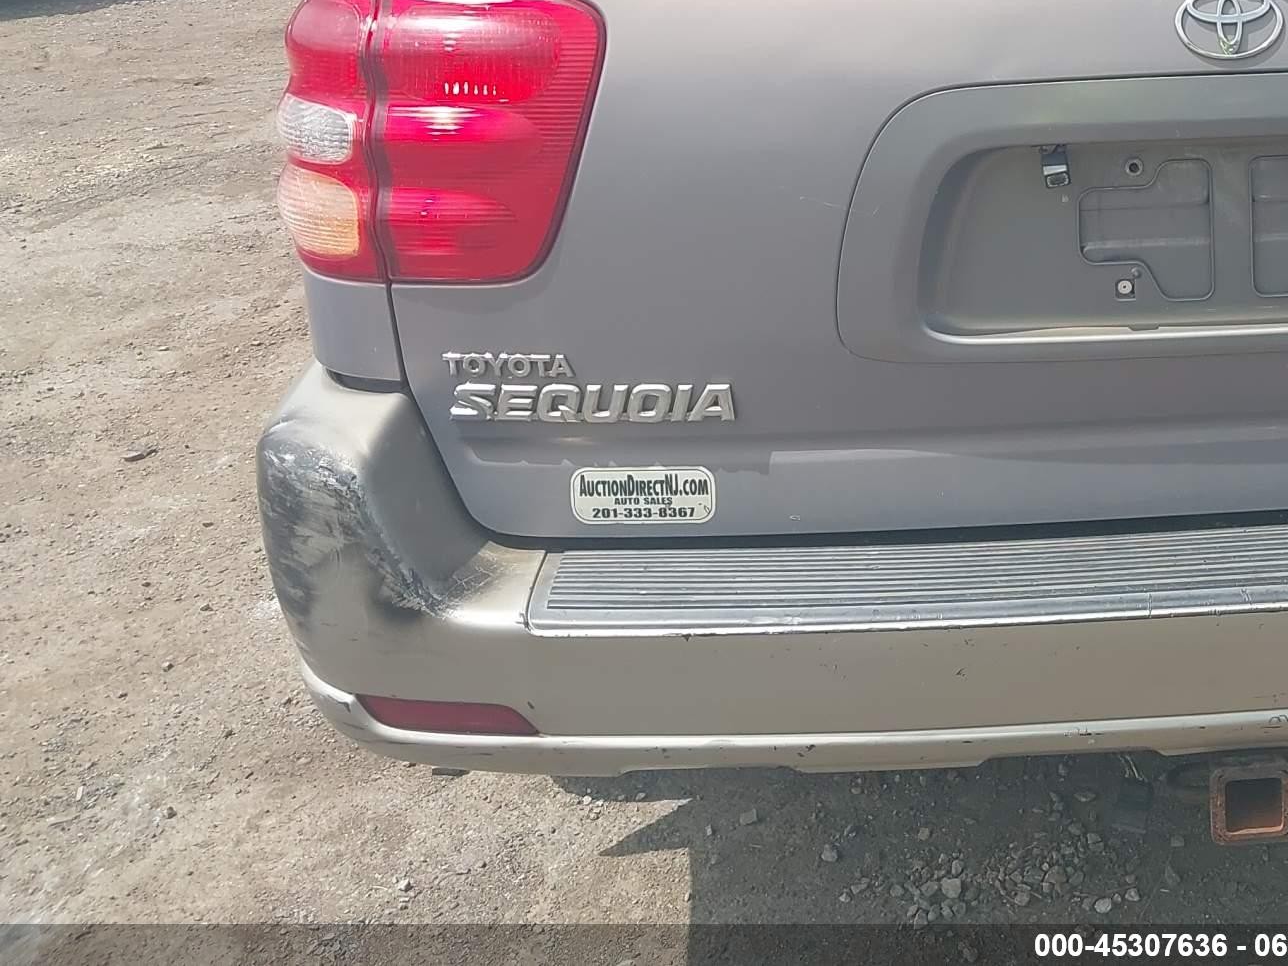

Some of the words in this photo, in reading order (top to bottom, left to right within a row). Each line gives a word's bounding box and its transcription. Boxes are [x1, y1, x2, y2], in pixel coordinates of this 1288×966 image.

[442, 351, 575, 377] TOYOTA
[449, 383, 735, 423] SEQUOIA
[614, 496, 640, 506] AUTO
[644, 496, 673, 506] SALES
[592, 507, 695, 519] 201-333-8367
